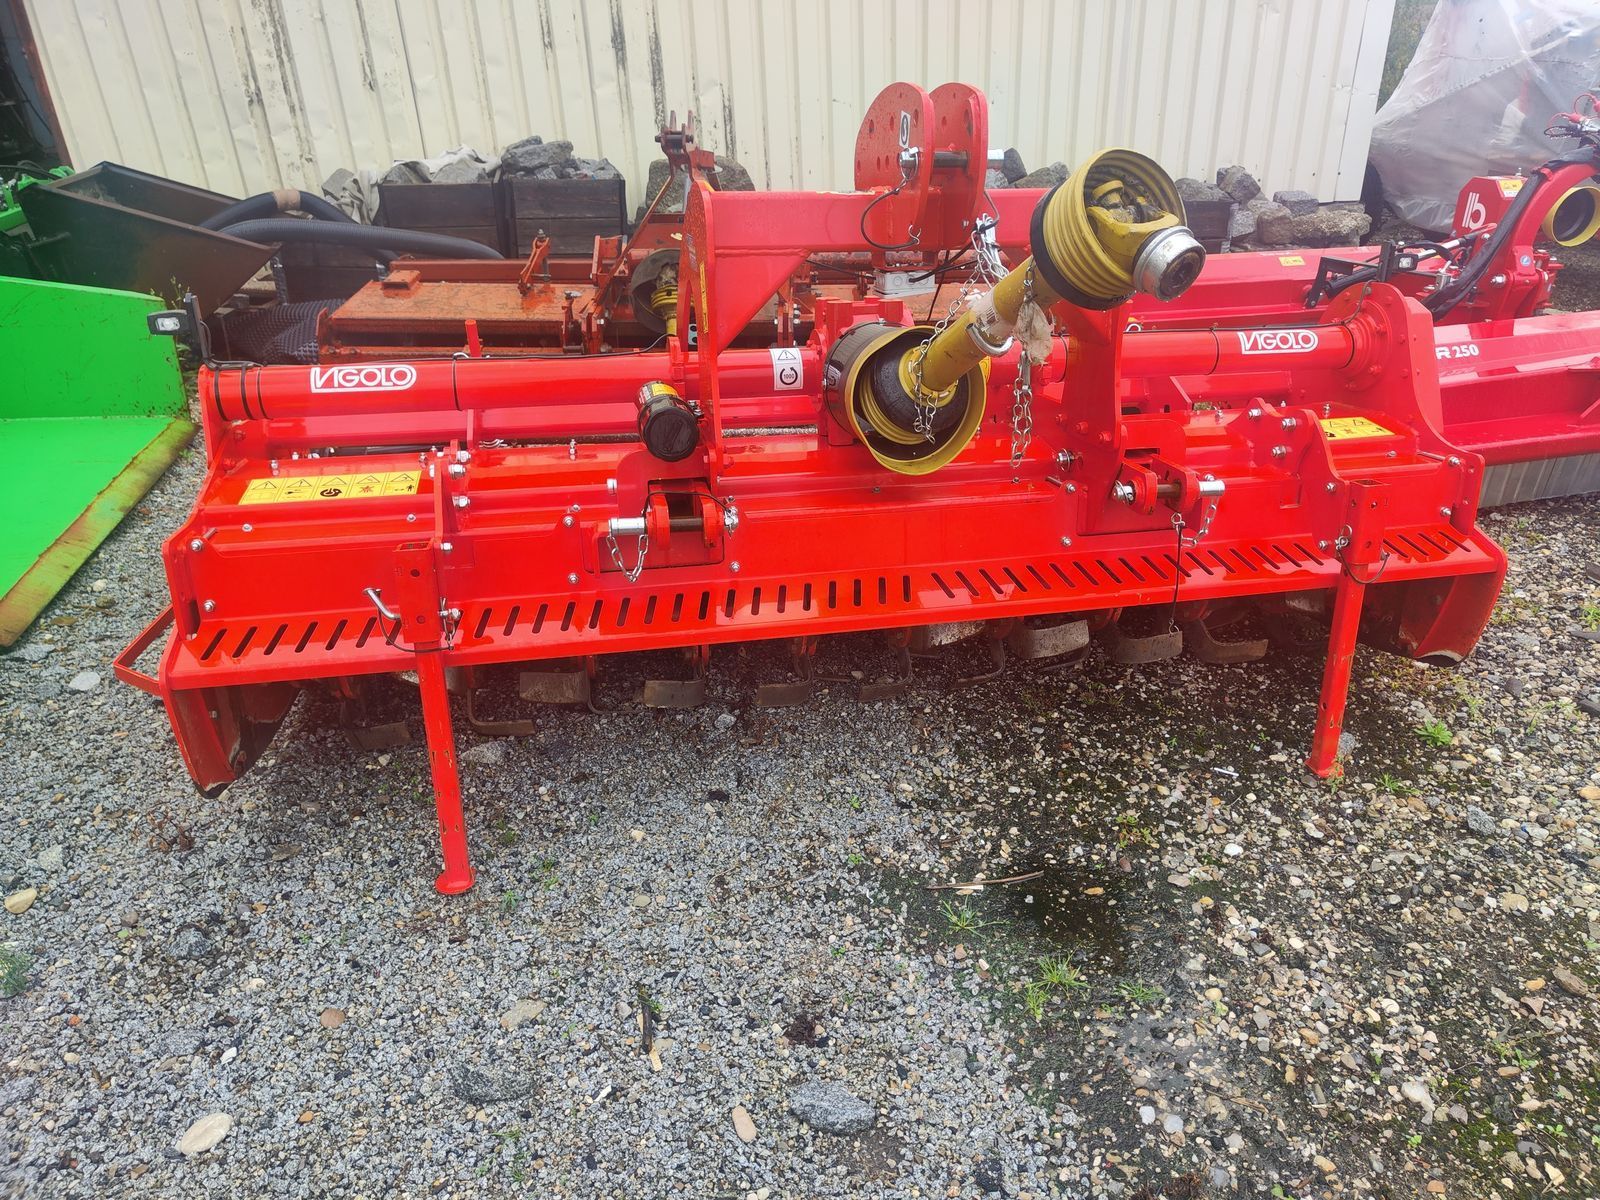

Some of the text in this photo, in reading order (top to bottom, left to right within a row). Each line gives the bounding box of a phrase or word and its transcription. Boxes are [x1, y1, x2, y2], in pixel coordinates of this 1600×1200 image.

[1239, 330, 1316, 352] VIGOLO
[1451, 344, 1480, 358] 250
[312, 364, 414, 390] VIGOLO
